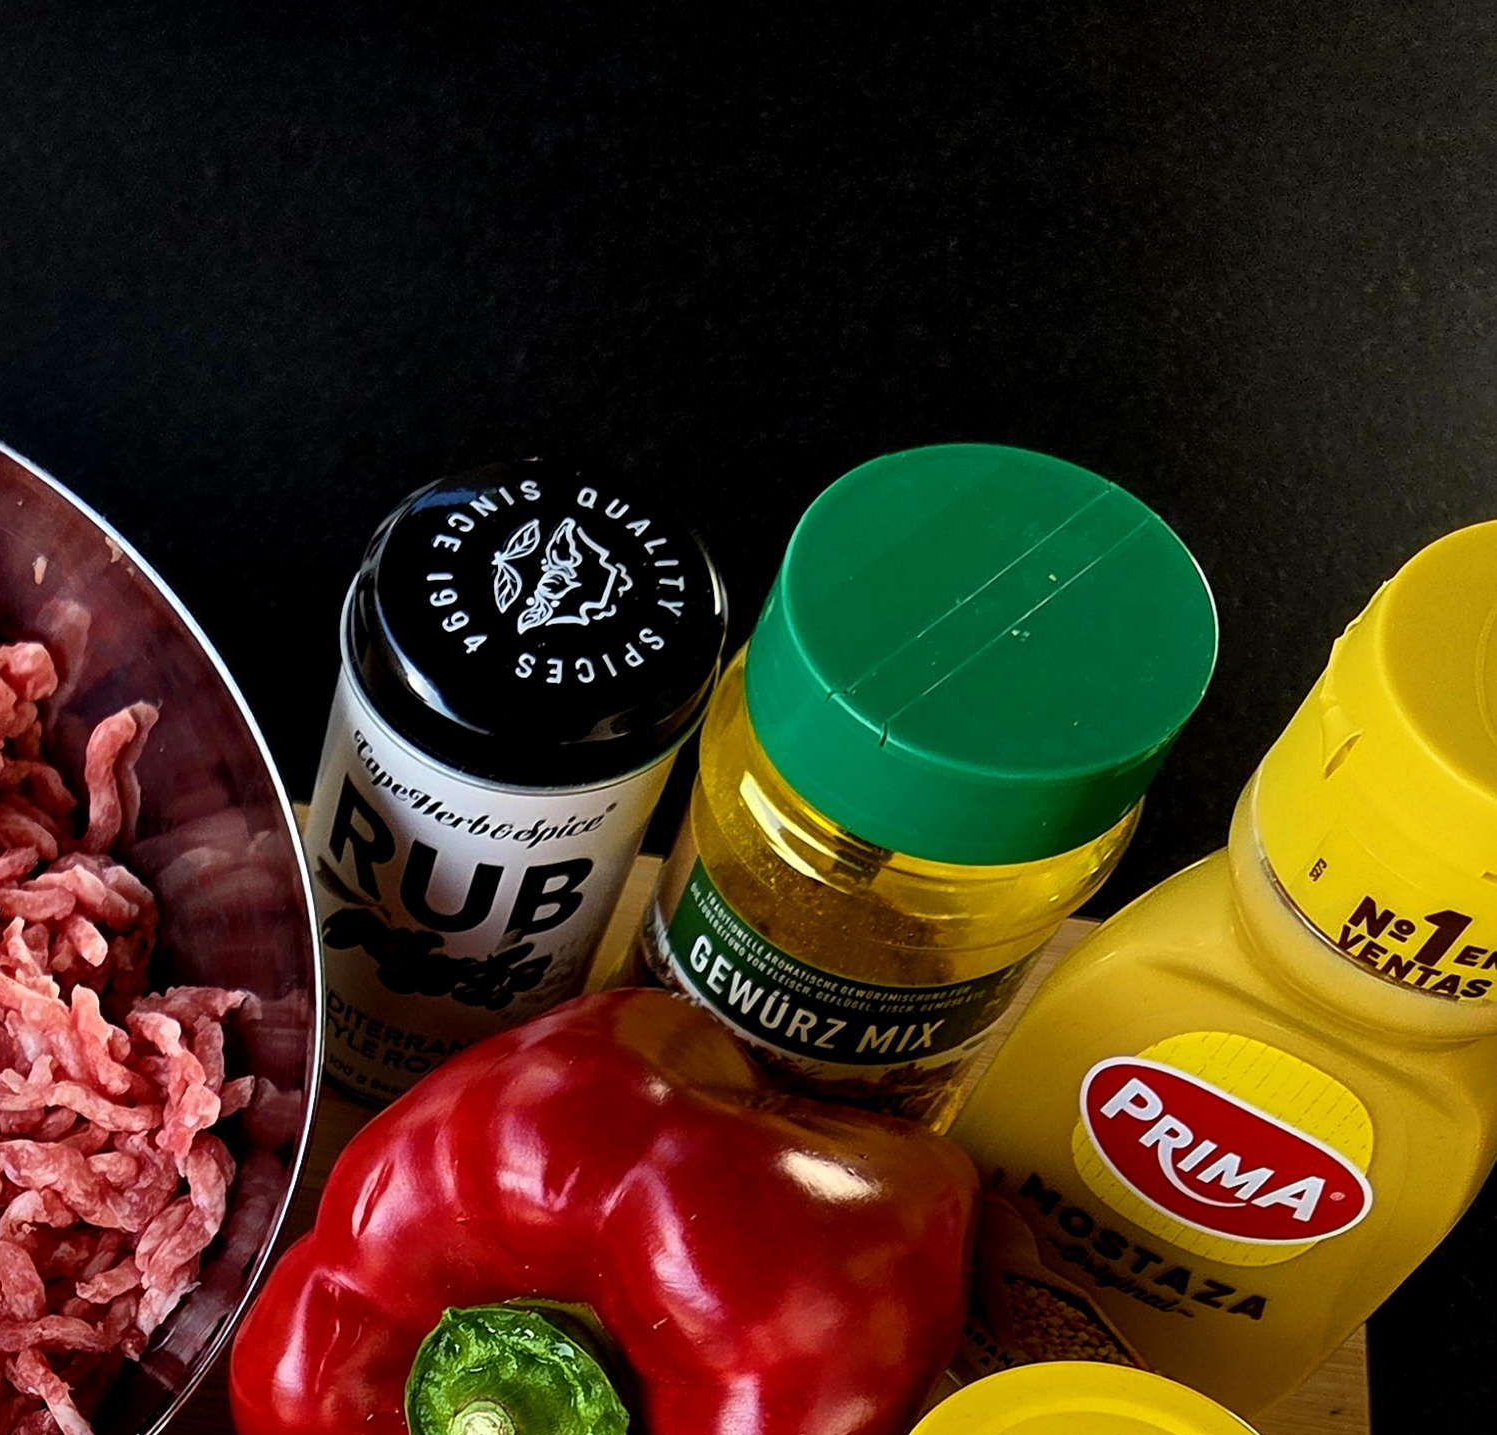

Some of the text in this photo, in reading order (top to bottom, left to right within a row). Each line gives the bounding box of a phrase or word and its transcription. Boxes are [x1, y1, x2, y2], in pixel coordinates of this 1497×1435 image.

[426, 479, 685, 685] QUALITY SPICES SINCE 1994
[329, 772, 594, 938] RUB
[706, 891, 765, 956] TRADITIONELLE
[764, 951, 839, 993] AROMATISCHE
[746, 952, 767, 972] VON
[1338, 923, 1493, 999] VENTAS
[1412, 909, 1474, 968] 1
[326, 990, 475, 1057] DITERRAN
[326, 1013, 432, 1074] YLE RO
[689, 934, 945, 1055] GEWÜRZ MIX
[1101, 1077, 1328, 1223] PRIMA
[1018, 1172, 1268, 1321] MOSTAZA
